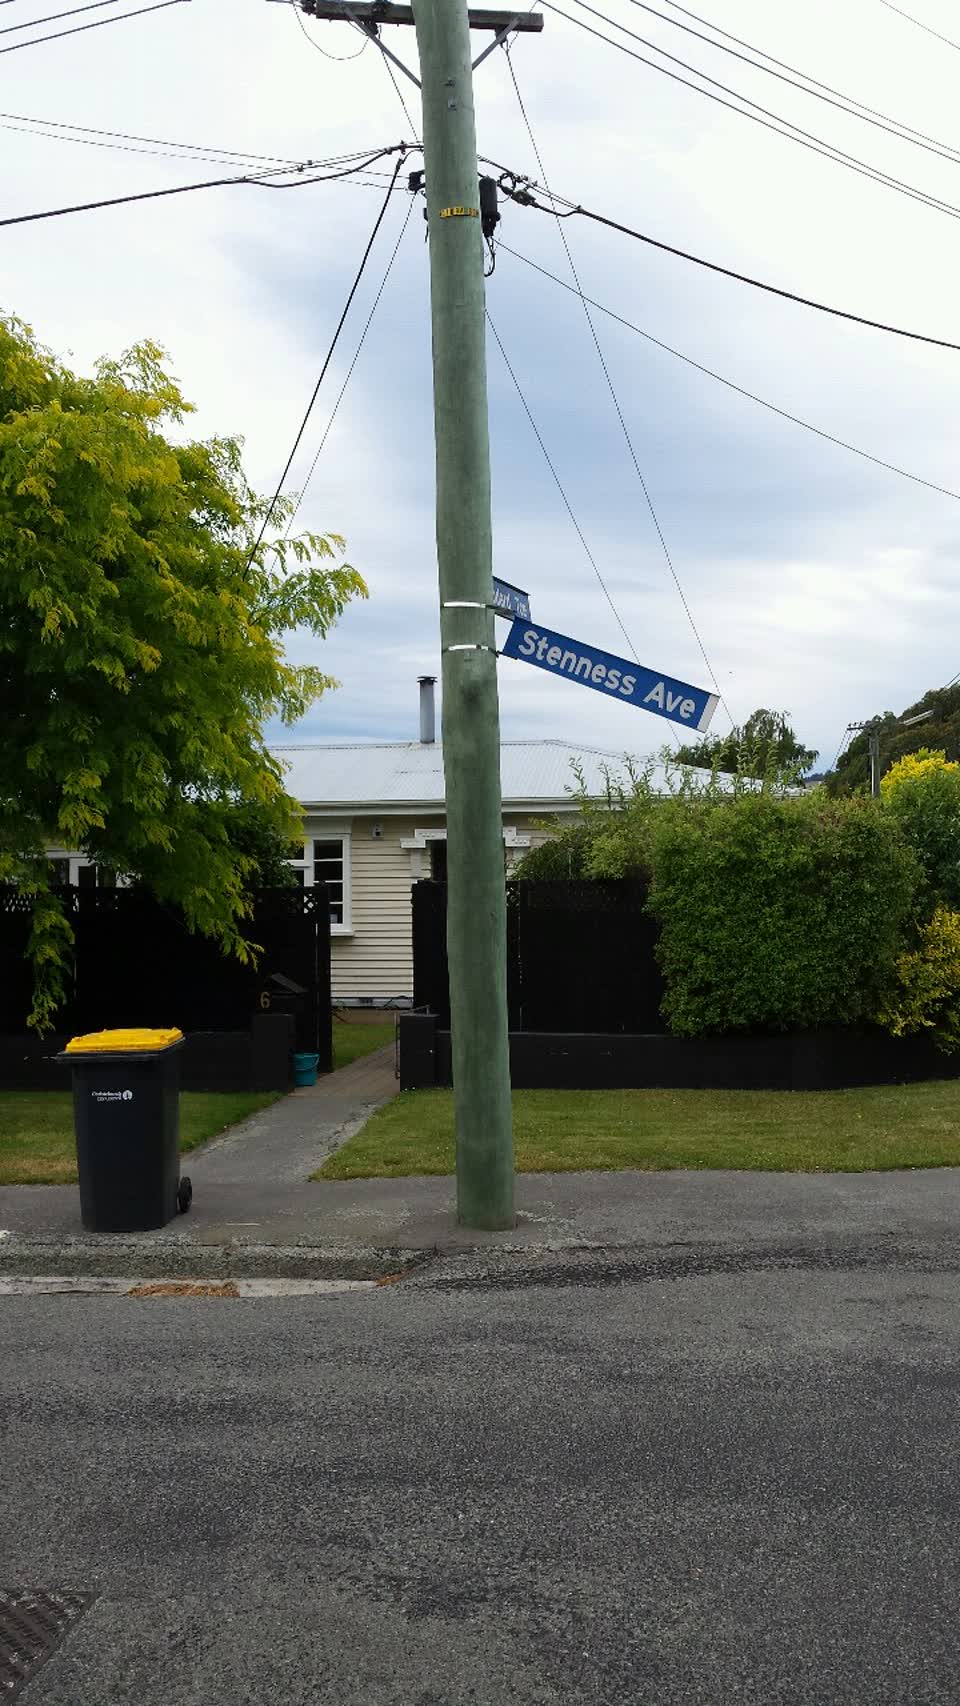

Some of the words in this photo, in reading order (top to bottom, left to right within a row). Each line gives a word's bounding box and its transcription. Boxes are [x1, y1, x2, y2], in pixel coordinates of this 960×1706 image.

[518, 630, 637, 695] Stenness
[643, 682, 696, 719] Ave
[260, 992, 270, 1008] 6
